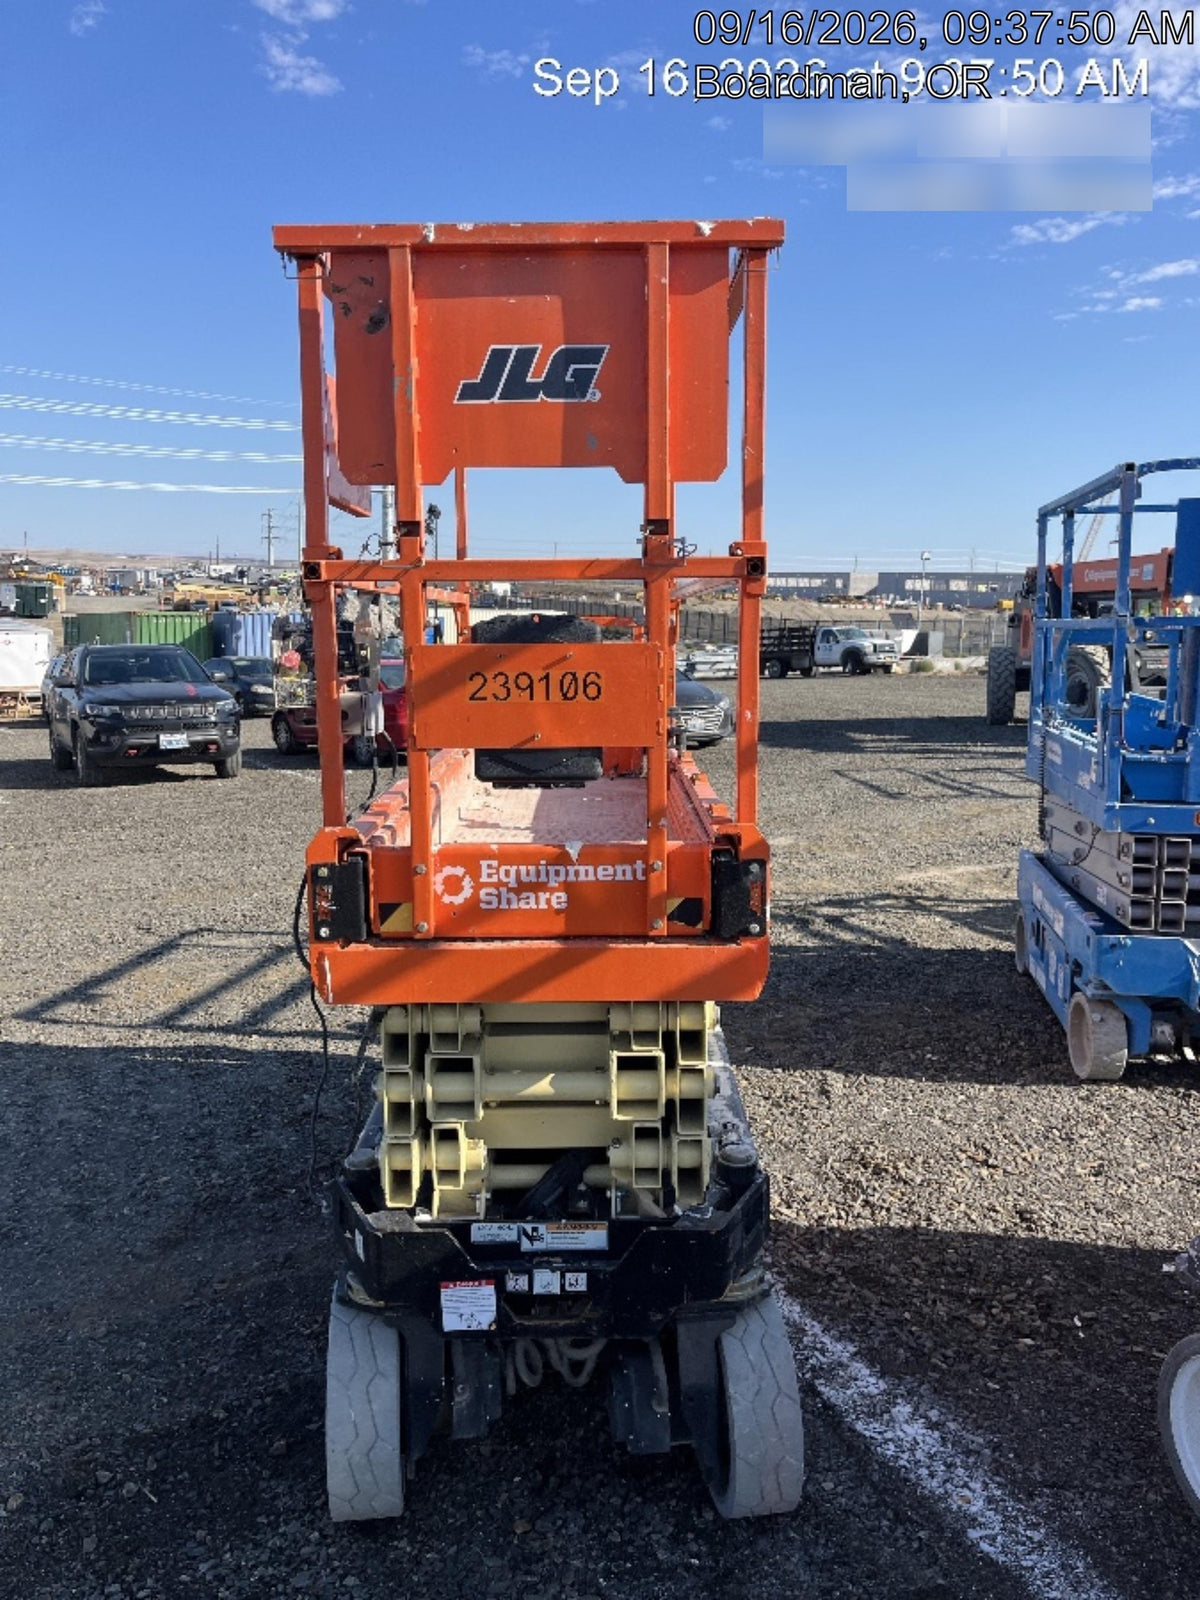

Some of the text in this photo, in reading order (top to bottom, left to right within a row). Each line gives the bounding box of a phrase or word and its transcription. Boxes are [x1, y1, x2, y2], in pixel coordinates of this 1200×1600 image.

[468, 671, 603, 702] 239106
[479, 860, 646, 888] Equipment
[479, 886, 569, 910] Share
